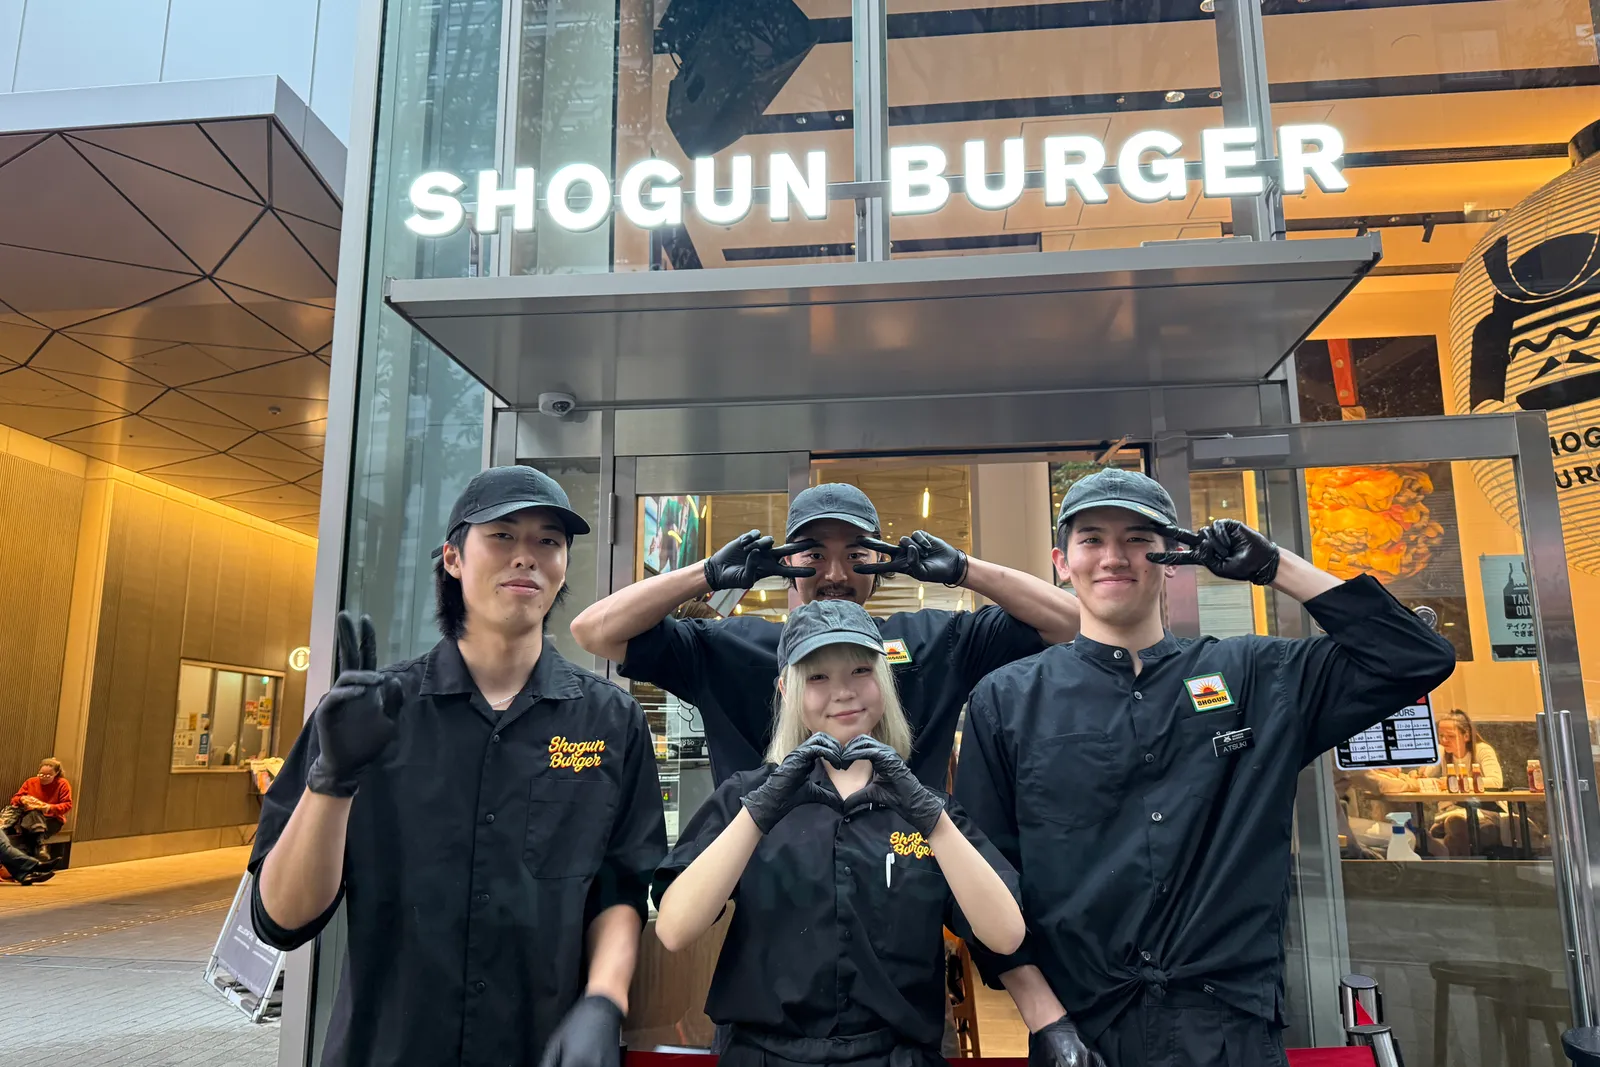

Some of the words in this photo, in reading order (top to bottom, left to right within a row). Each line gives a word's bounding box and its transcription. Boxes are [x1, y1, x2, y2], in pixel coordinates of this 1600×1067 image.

[404, 150, 828, 238] SHOGUN
[889, 123, 1349, 217] BURGER
[1197, 695, 1228, 706] SHOGUN
[548, 735, 606, 757] Shogun
[1223, 741, 1247, 753] ATSUKI
[549, 751, 602, 773] Burger
[889, 831, 929, 845] Shog
